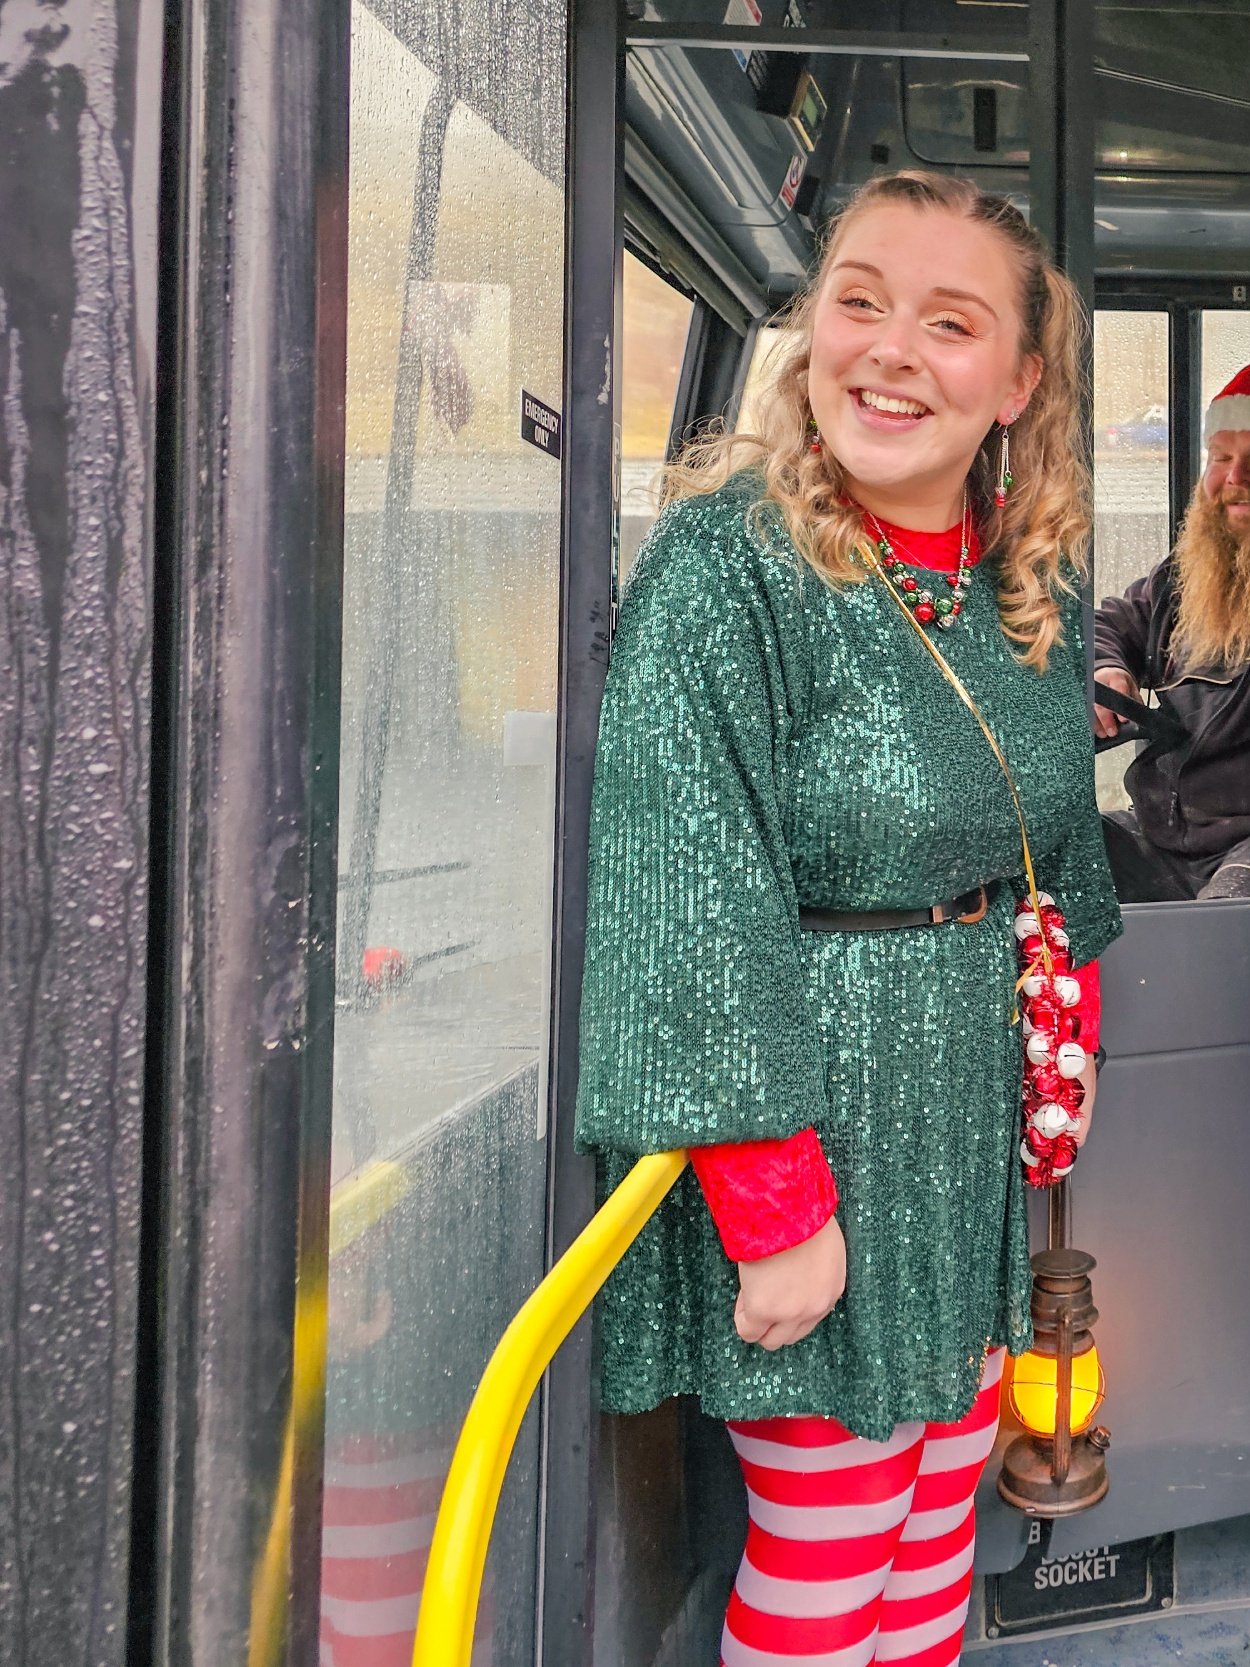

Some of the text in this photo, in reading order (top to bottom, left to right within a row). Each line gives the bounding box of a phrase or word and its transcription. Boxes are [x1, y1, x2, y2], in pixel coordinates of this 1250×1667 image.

[525, 398, 559, 435] EMERGENCY
[534, 425, 550, 448] ONLY
[1034, 1553, 1120, 1590] SOCKET
